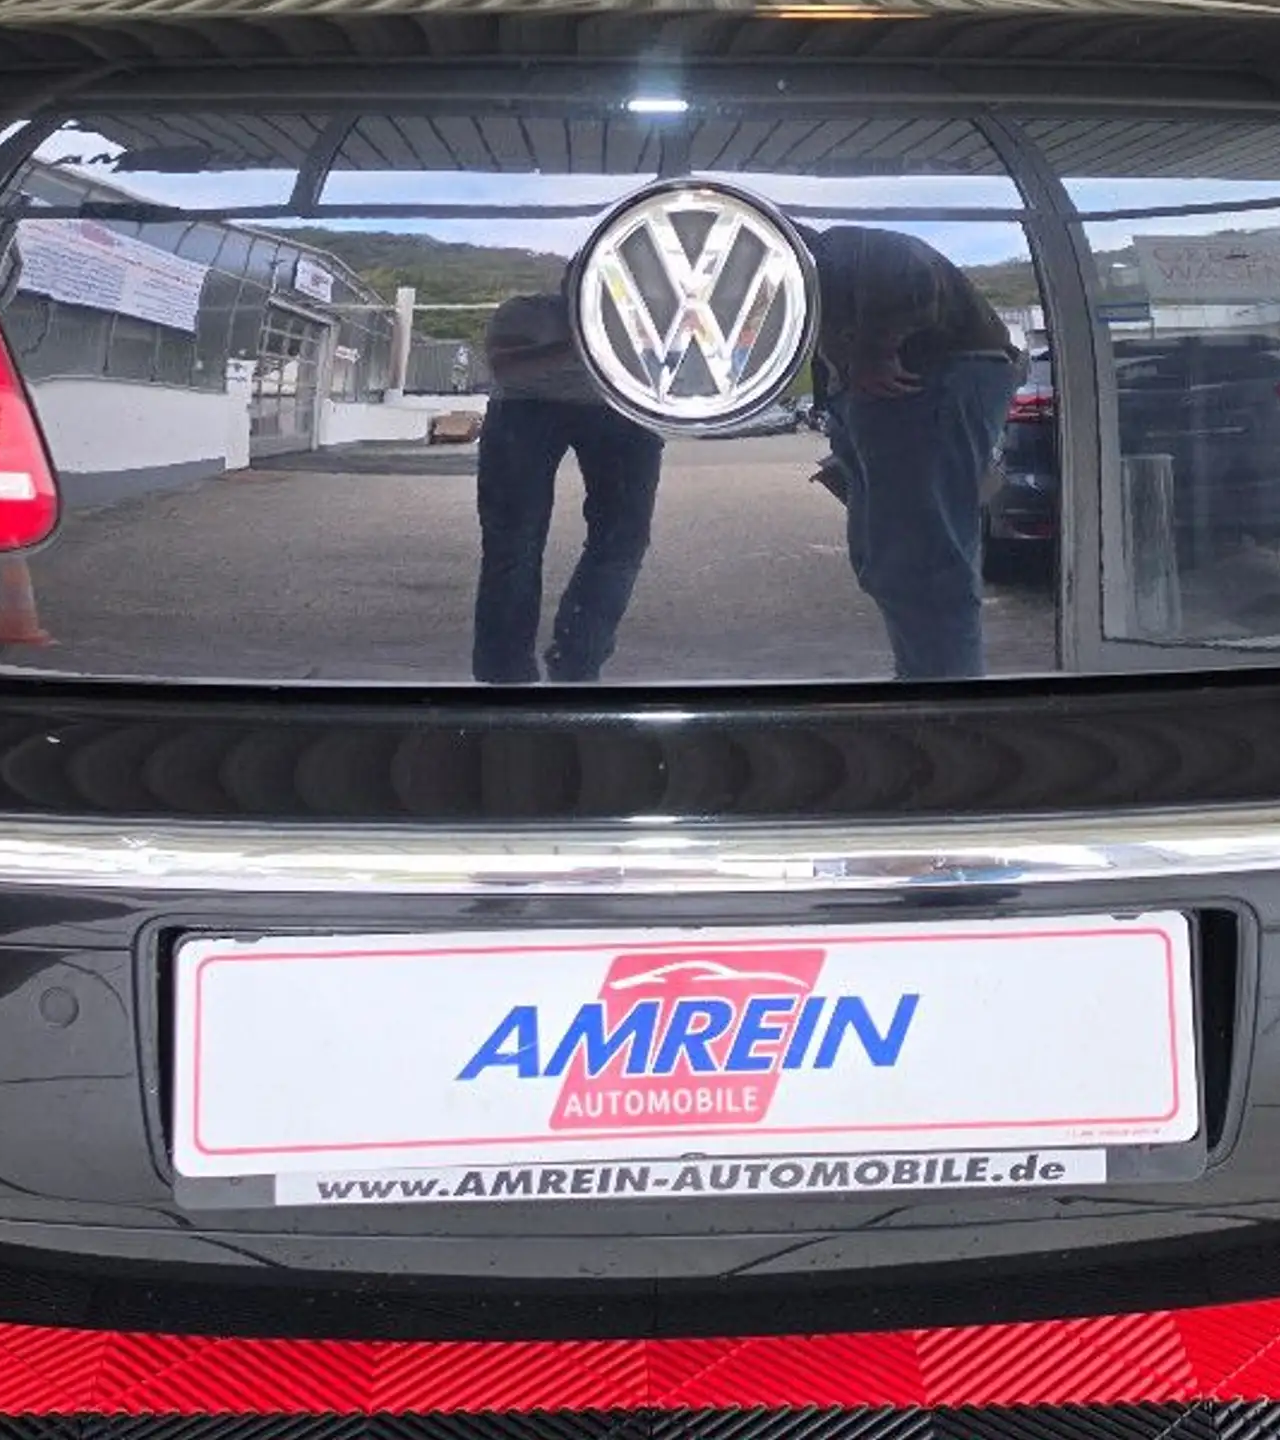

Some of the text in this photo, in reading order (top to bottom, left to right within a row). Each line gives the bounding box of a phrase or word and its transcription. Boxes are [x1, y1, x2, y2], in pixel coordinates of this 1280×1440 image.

[454, 992, 922, 1081] AMREIN
[563, 1086, 759, 1120] AUTOMOBILE
[317, 1153, 1067, 1200] www.AMREIN-AUTOMOBILE.de
